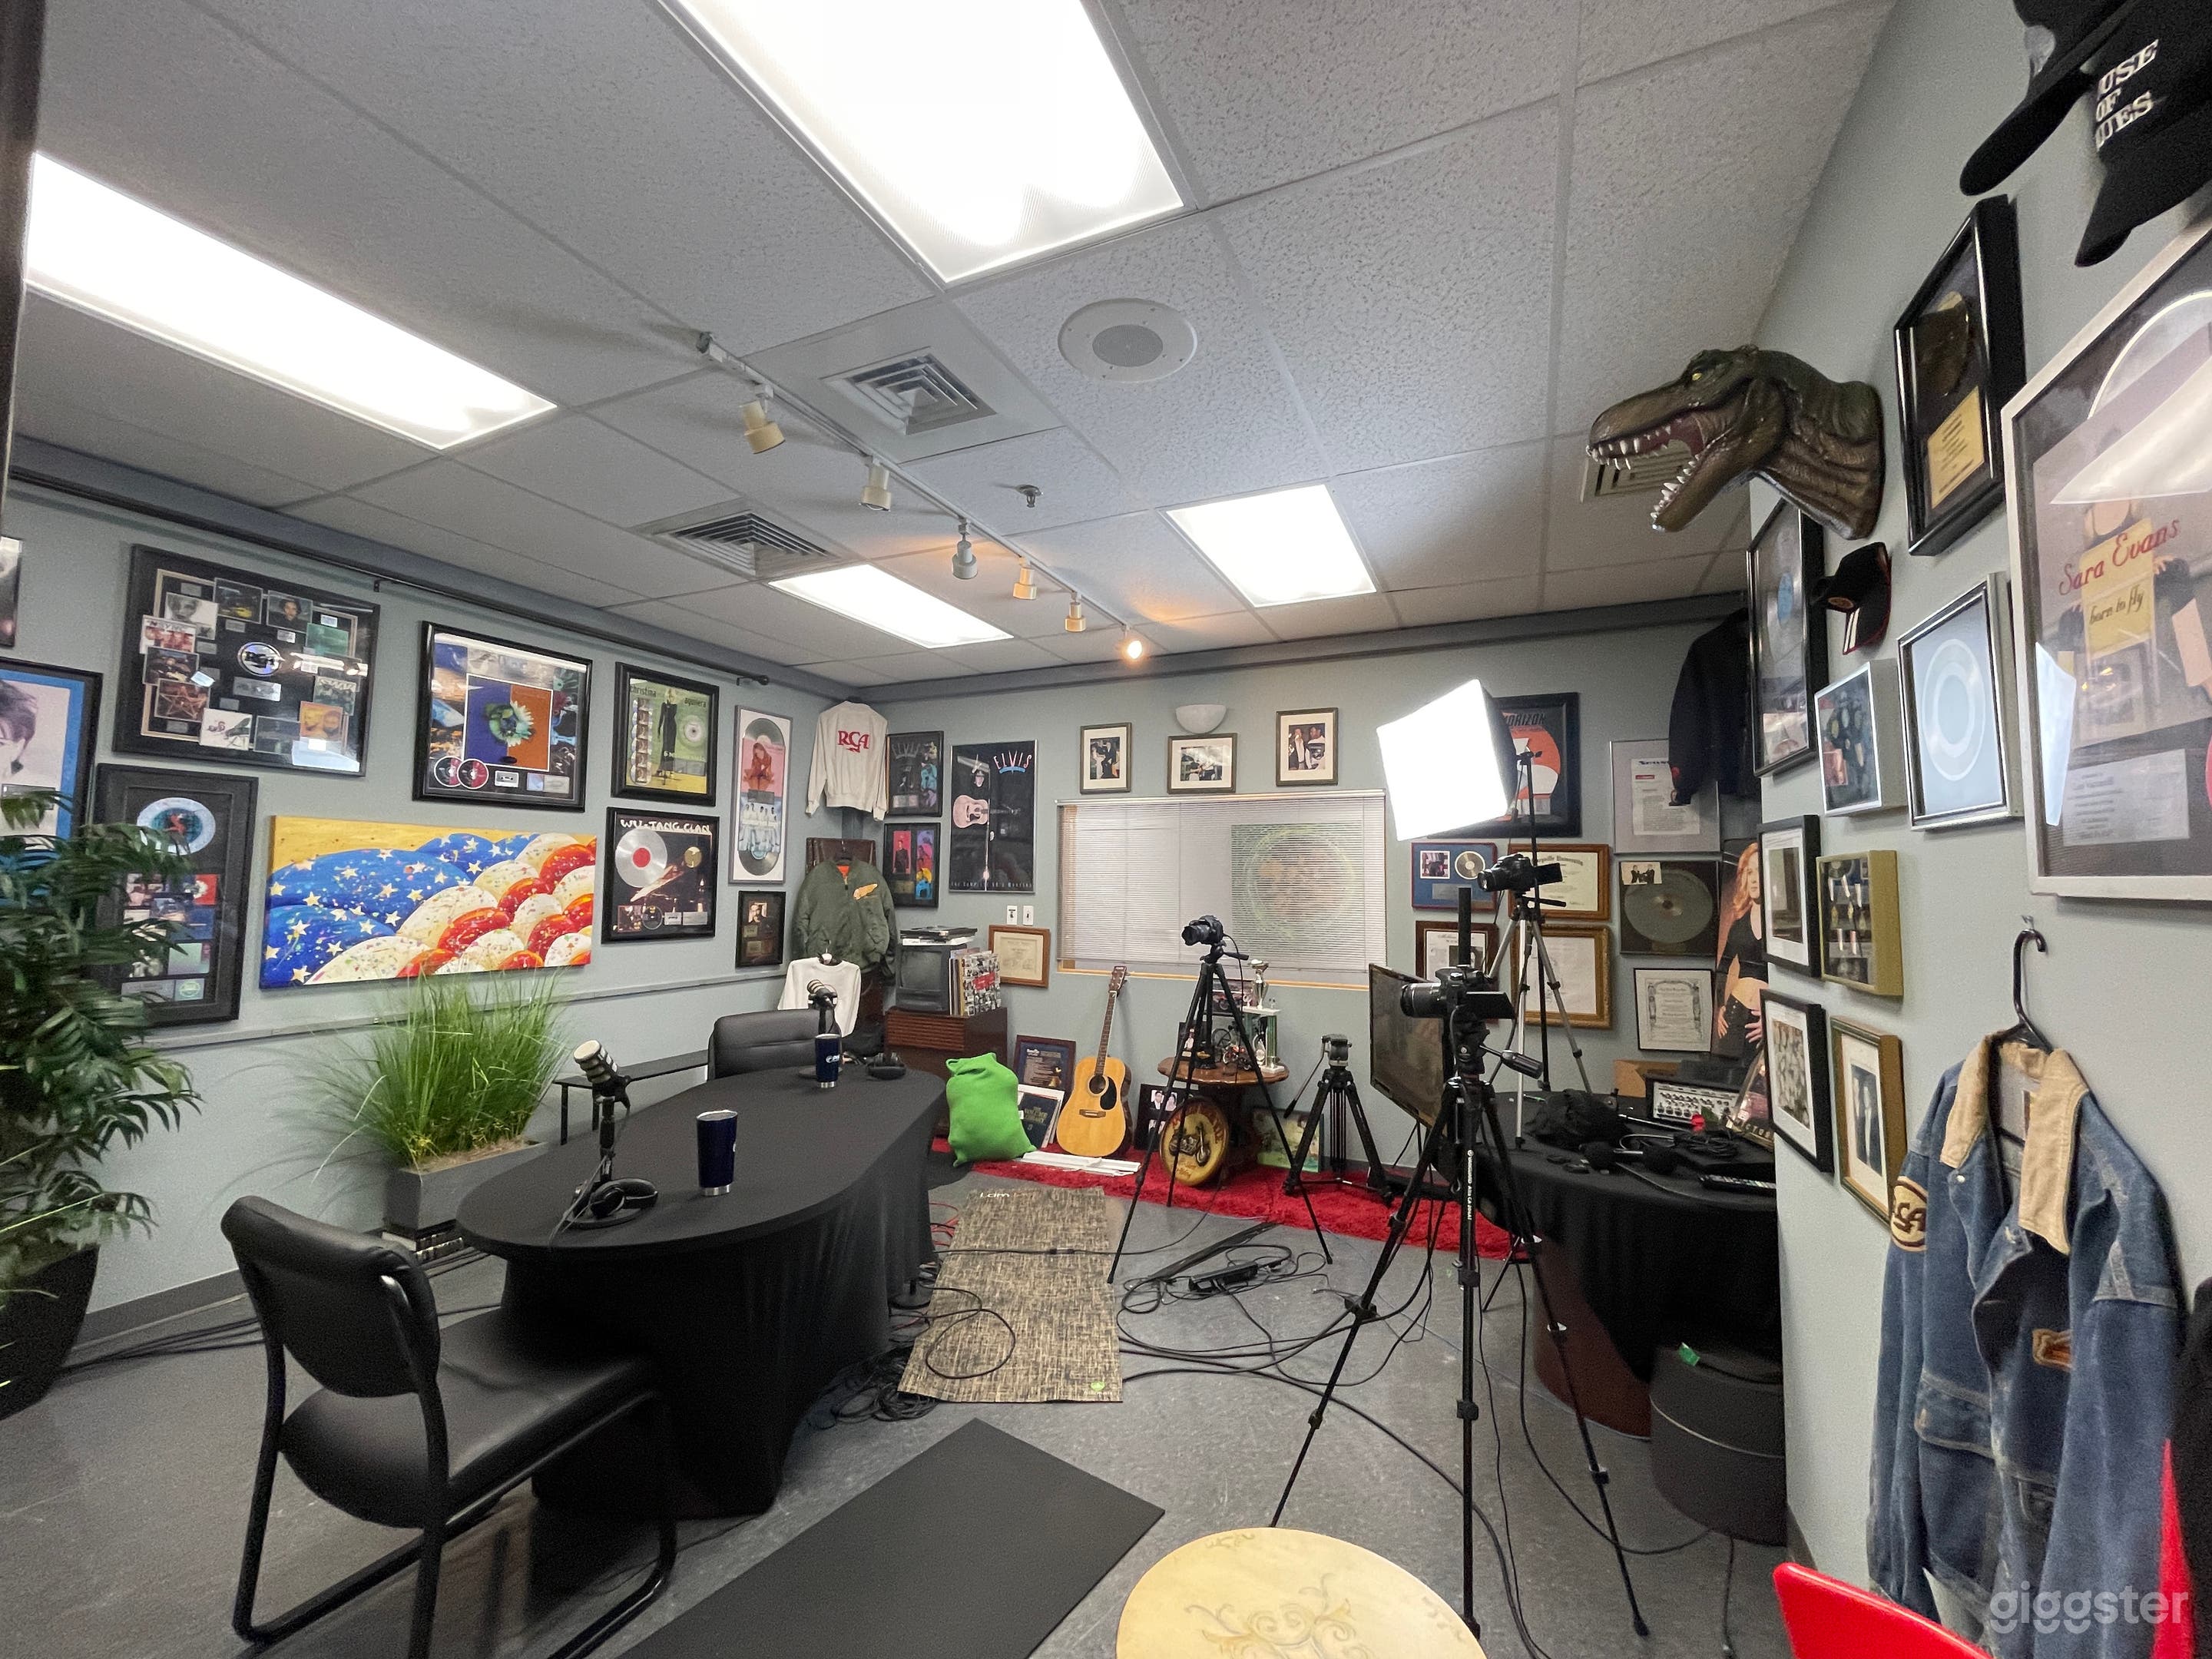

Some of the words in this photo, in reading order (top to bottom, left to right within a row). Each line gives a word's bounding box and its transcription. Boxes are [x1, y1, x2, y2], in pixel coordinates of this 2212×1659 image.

[2098, 39, 2159, 101] USE
[2096, 87, 2122, 122] OF
[2058, 563, 2105, 595] Sara
[2112, 519, 2180, 567] Evans
[2116, 597, 2127, 613] to
[2127, 584, 2144, 615] fly
[1506, 713, 1546, 726] ORIZON
[837, 730, 870, 753] RCA
[993, 750, 1032, 770] ELVIS
[683, 823, 711, 834] CLAN
